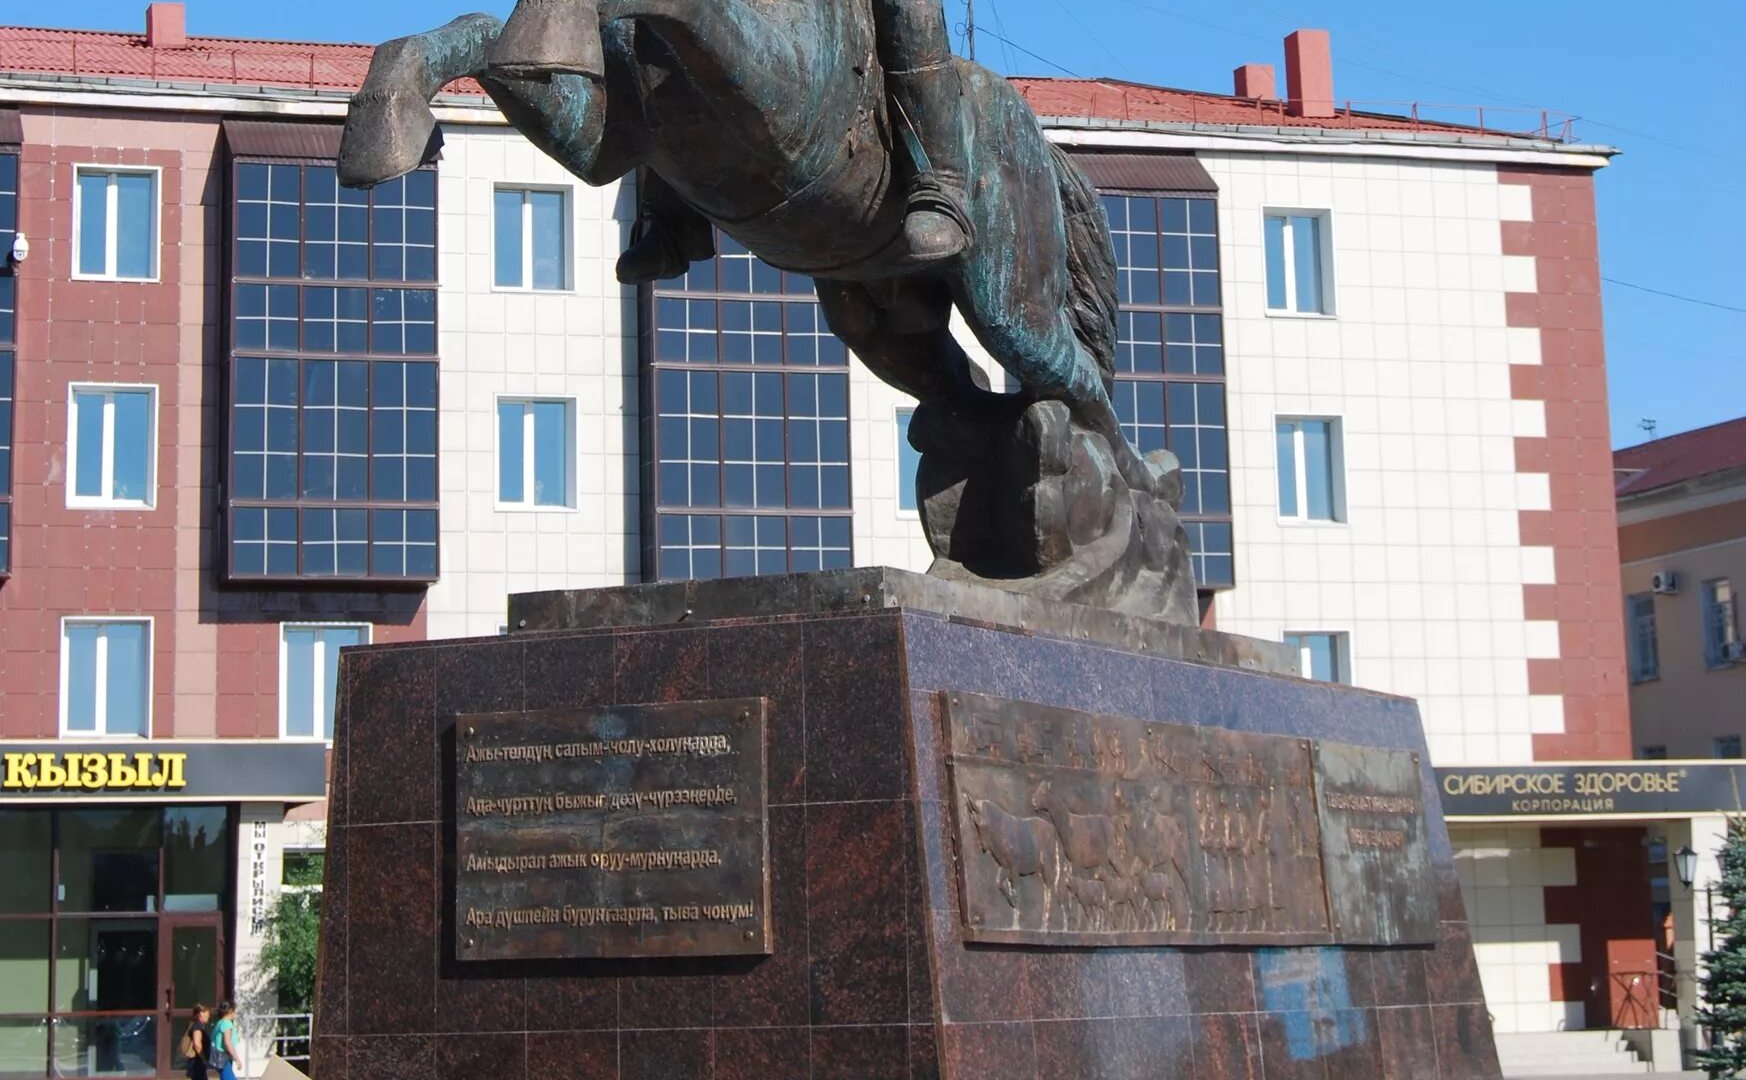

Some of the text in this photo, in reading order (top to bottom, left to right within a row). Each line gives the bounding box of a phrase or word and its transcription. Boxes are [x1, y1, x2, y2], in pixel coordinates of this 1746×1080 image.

[3, 753, 187, 788] КЫЗЫЛ
[1444, 772, 1680, 796] СИБИРСКОЕ ЗДОРОВЬЕ
[1512, 798, 1614, 813] КОРПОРАЦИЯ
[548, 851, 588, 869] ажык
[465, 907, 492, 928] Ара
[661, 904, 699, 921] тыва
[702, 899, 754, 924] чонум!
